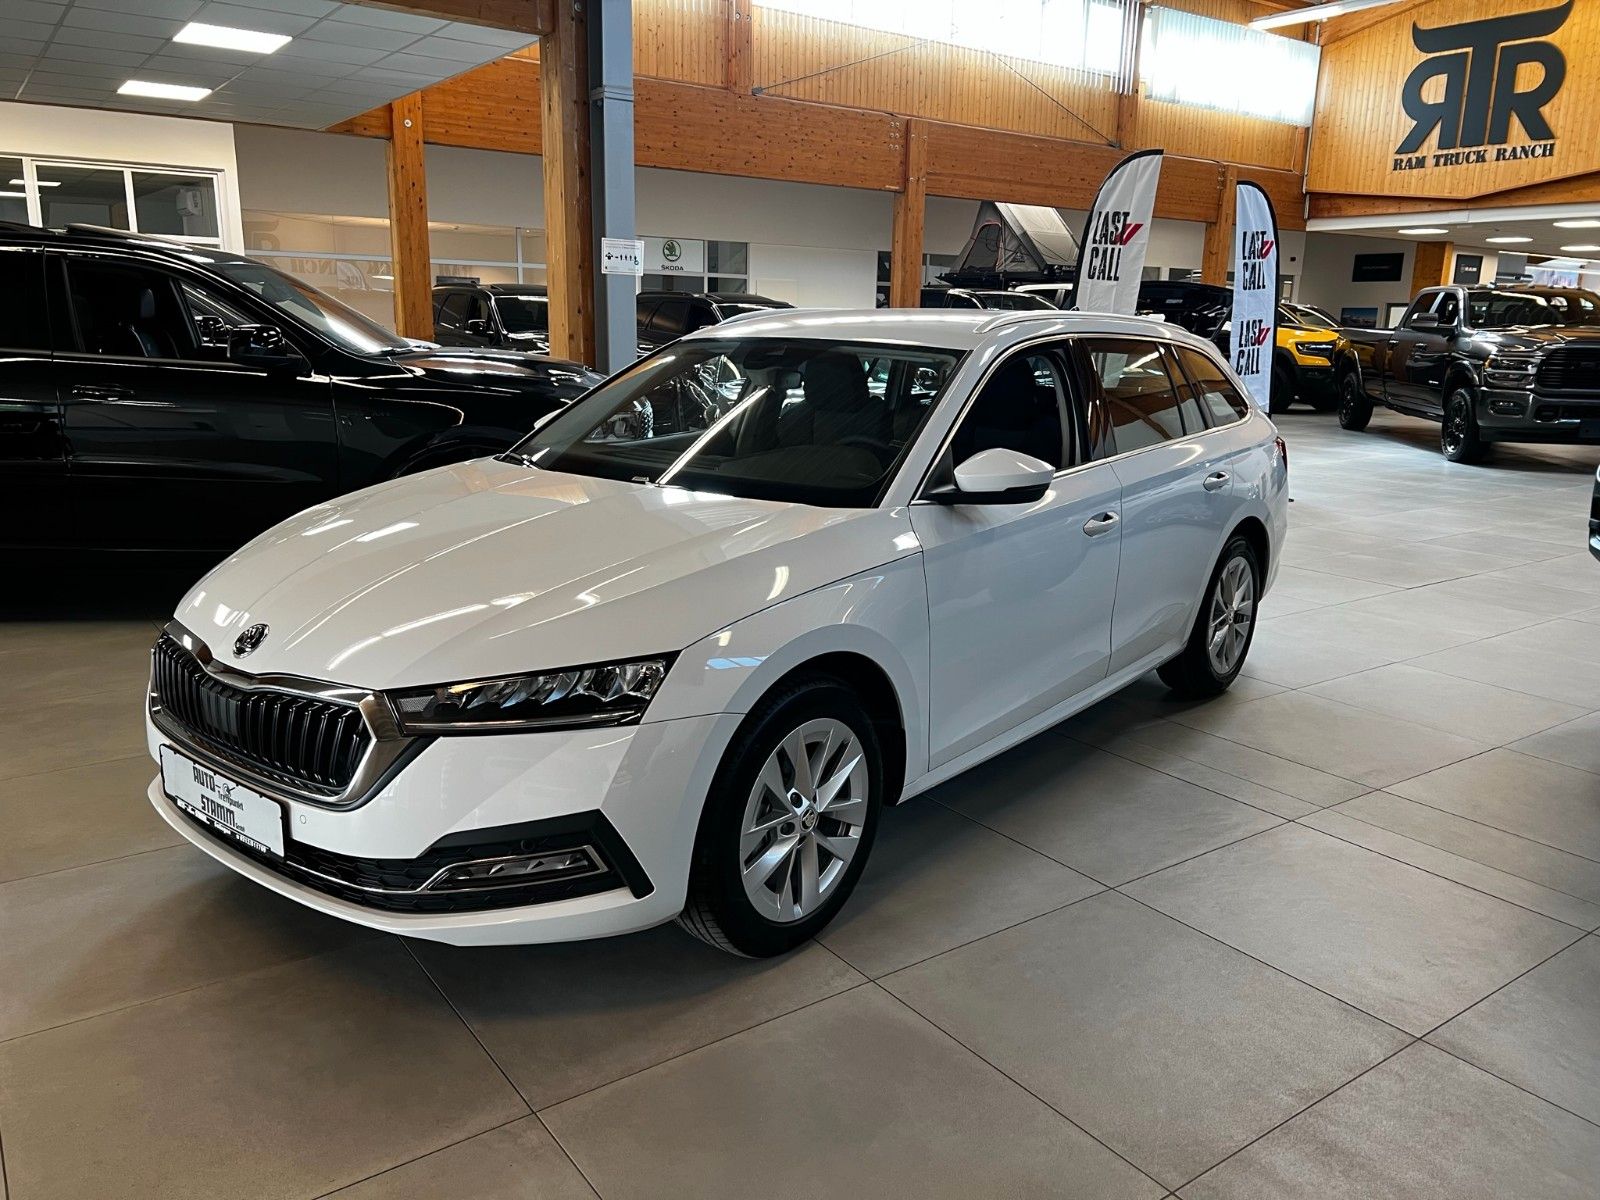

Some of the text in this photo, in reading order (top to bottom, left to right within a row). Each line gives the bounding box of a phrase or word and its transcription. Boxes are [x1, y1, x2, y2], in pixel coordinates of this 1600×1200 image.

[1392, 143, 1556, 171] RAM TRUCK RANCH
[1092, 211, 1130, 245] LAST
[1242, 231, 1267, 260] LAST
[1087, 246, 1122, 281] CALL
[1242, 261, 1266, 291] CALL
[1238, 319, 1264, 348] LAST
[1236, 346, 1260, 376] CALL
[201, 794, 236, 828] STAMM
